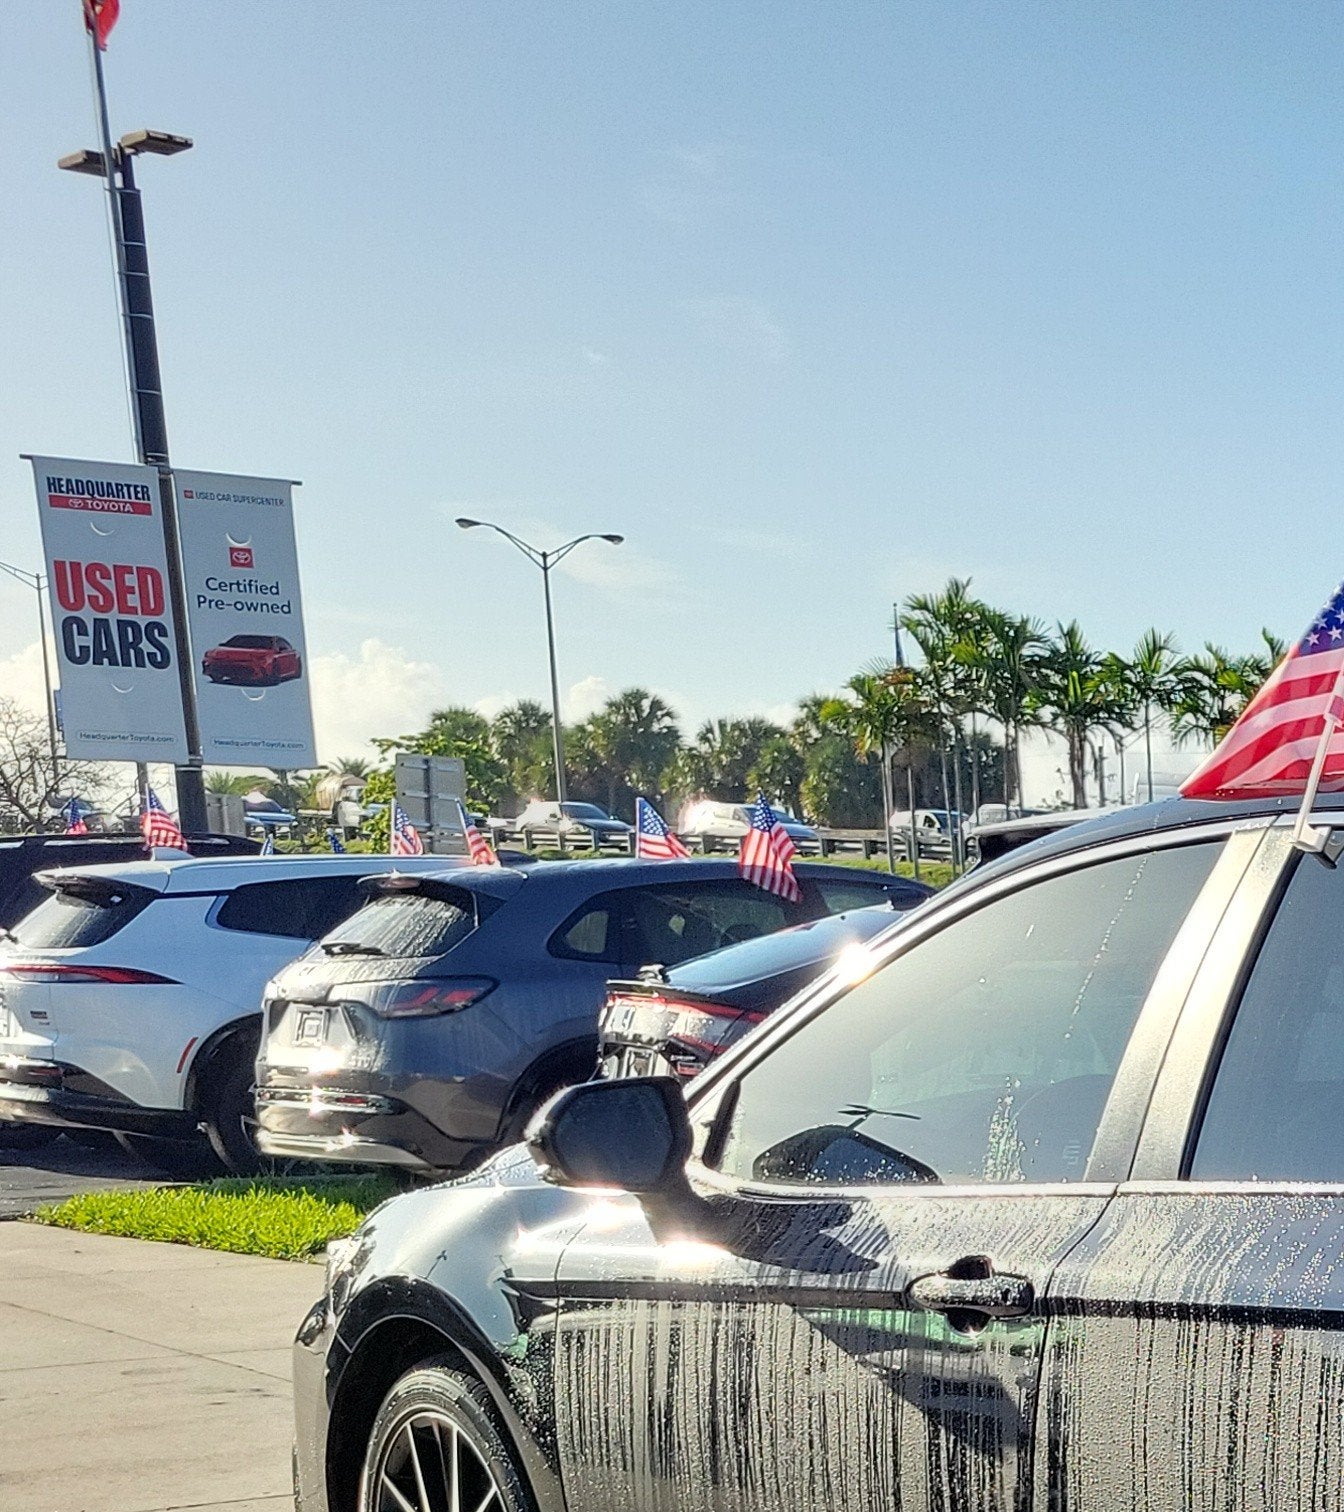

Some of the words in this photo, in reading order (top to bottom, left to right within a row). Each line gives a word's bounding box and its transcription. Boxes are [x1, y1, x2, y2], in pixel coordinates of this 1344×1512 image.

[46, 476, 151, 501] HEADQUARTER
[86, 500, 134, 513] TOYOTA
[54, 560, 165, 616] USED
[205, 577, 279, 596] Certified
[197, 595, 292, 614] Pre-owned
[62, 616, 171, 670] CARS
